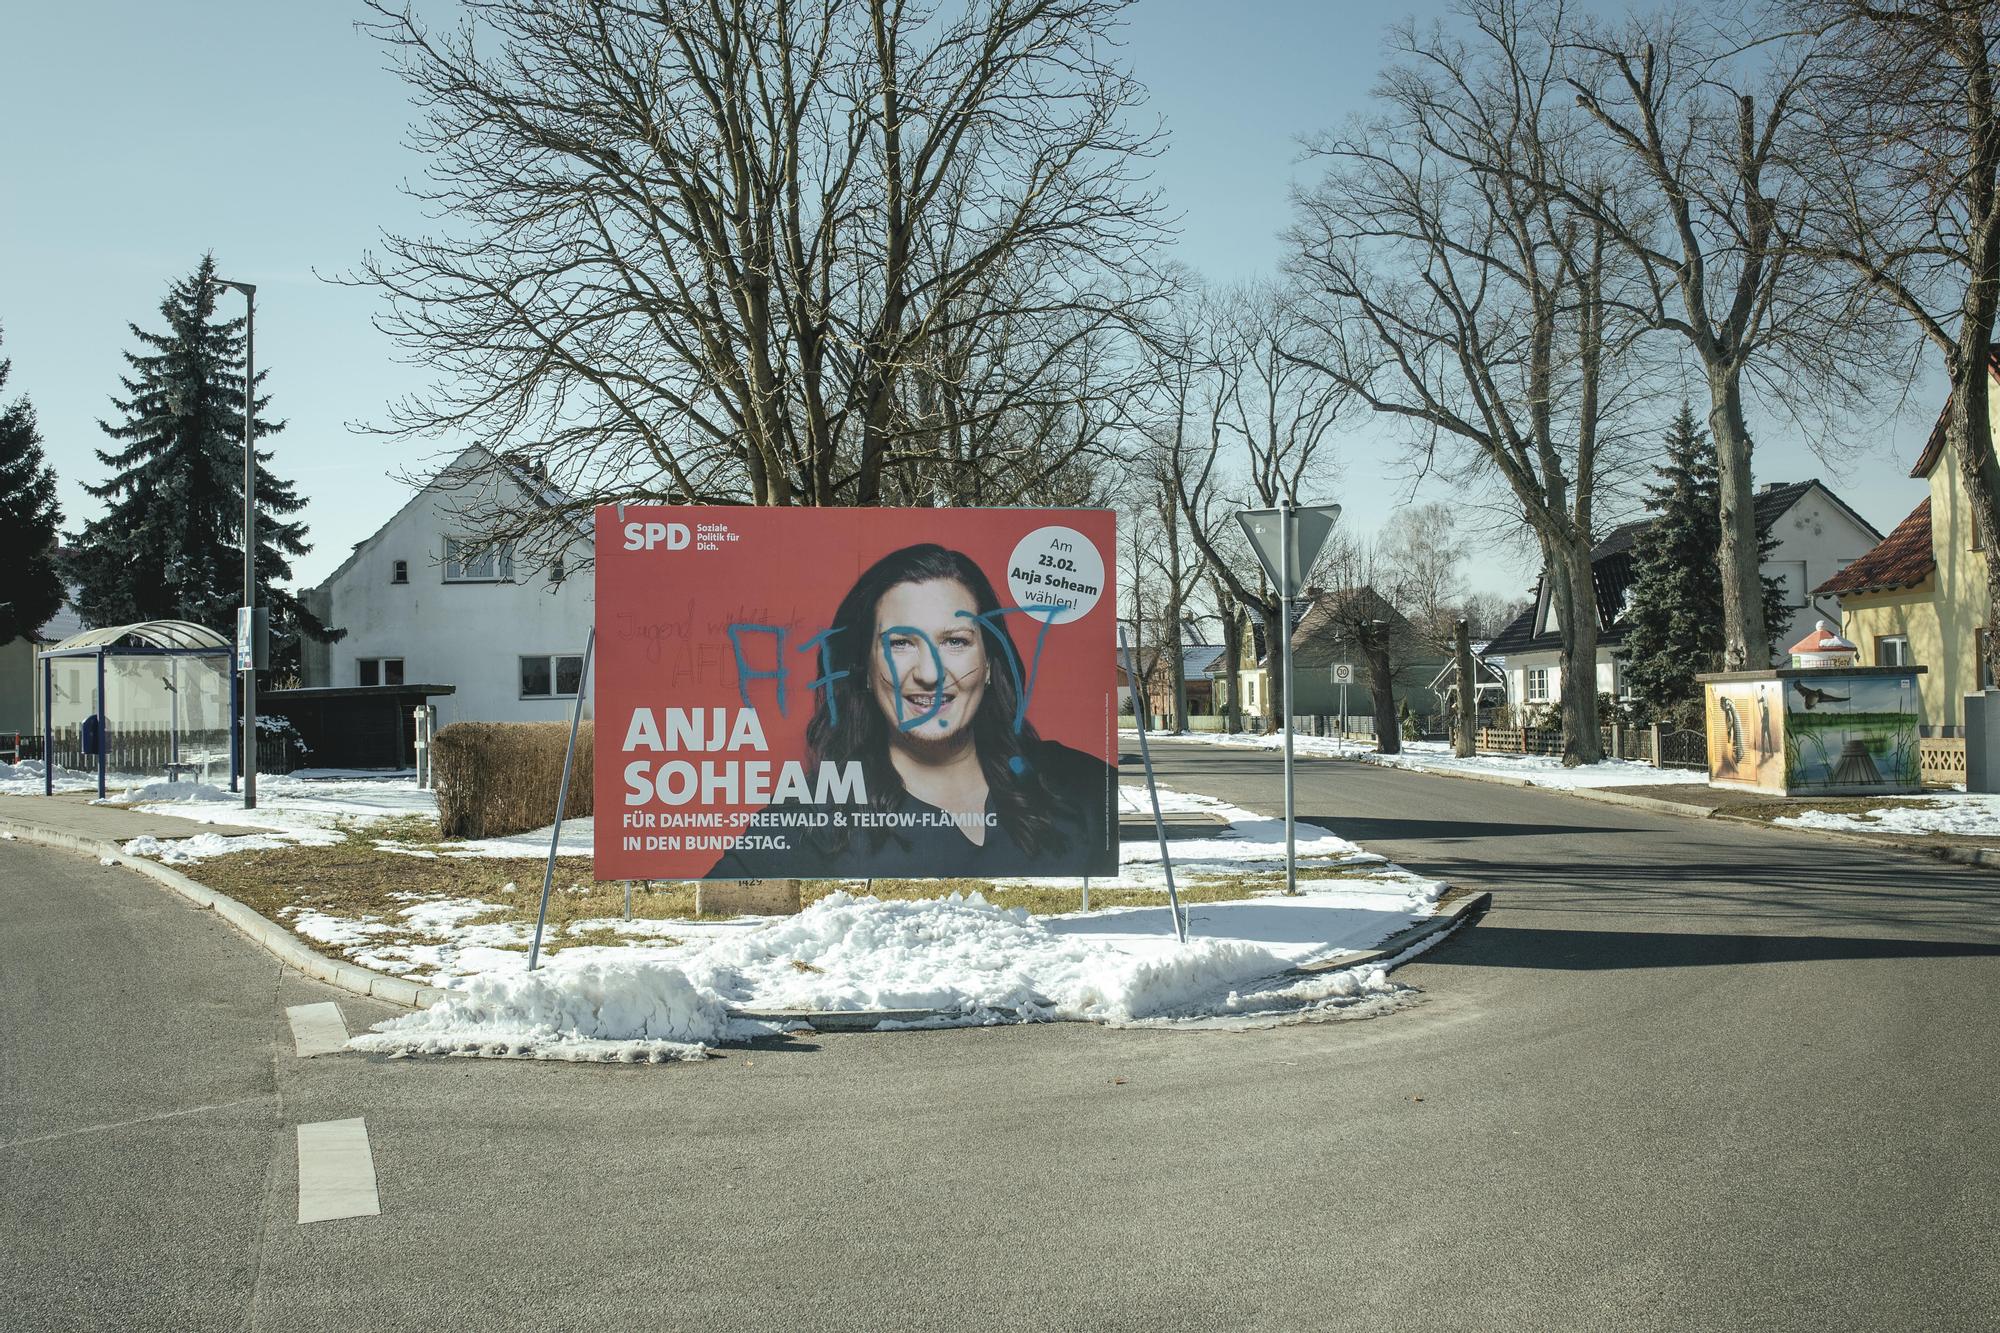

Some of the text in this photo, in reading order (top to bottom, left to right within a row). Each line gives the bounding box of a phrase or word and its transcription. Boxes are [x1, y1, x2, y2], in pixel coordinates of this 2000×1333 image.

[624, 522, 691, 551] SPD
[696, 523, 728, 532] Soziale
[697, 532, 740, 542] Politik für
[697, 542, 719, 551] Dich.
[1050, 538, 1073, 552] Am
[1038, 554, 1077, 573] 23.02.
[1011, 567, 1097, 596] Anja Soheam
[1025, 590, 1078, 610] wählen!
[622, 707, 768, 752] ANJA
[623, 760, 868, 805] SOHEAM
[623, 809, 998, 828] FÜR DAHME-SPREEWALD & TELTOW-FLÄMING
[623, 835, 791, 851] IN DEN BUNDESTAG.
